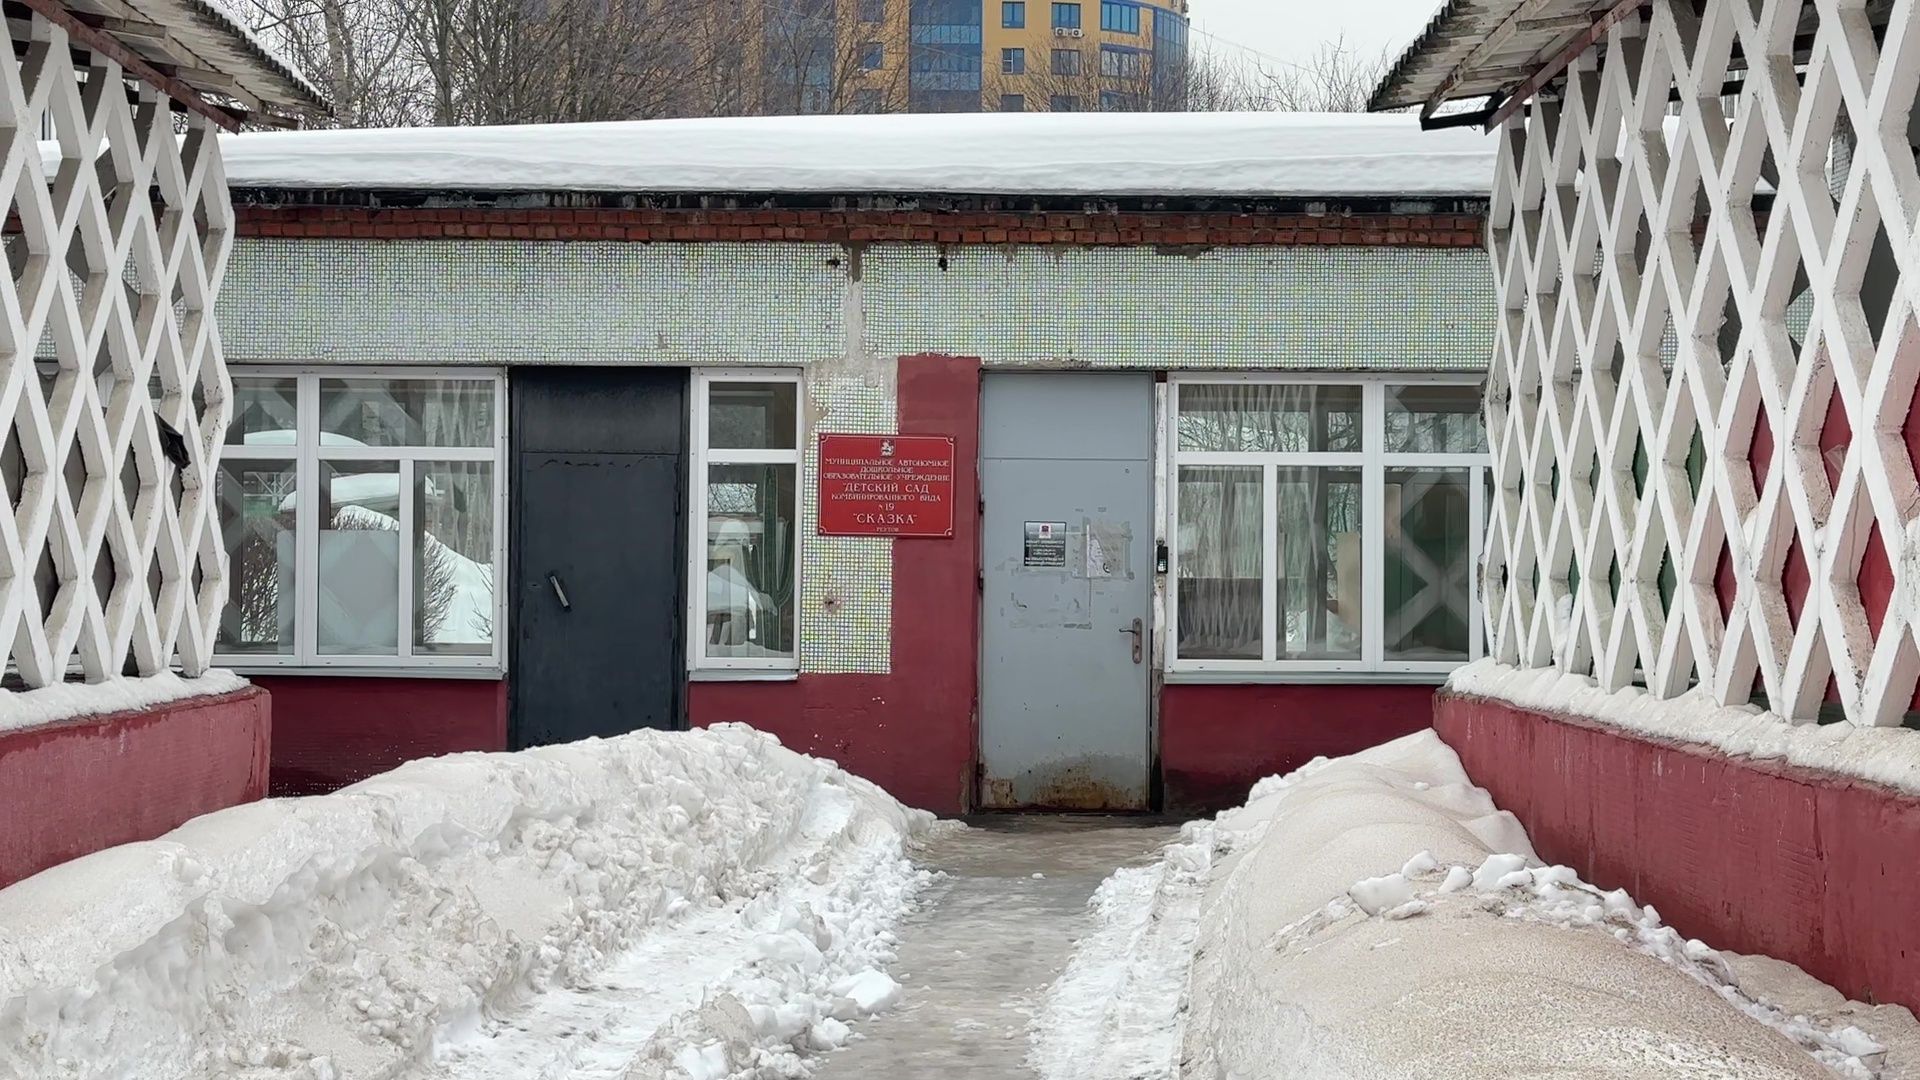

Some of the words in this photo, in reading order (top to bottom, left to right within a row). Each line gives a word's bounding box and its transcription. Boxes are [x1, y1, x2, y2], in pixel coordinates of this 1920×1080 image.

[898, 459, 949, 467] АВТОНОМНОЕ
[860, 466, 914, 474] ДОШКОЛЬНОЕ
[823, 472, 893, 480] ОБРАЗОВАТЕЛЬНОЕ
[905, 484, 930, 494] САД
[831, 493, 916, 501] КОМБИНИРОВАННОГО
[885, 502, 896, 511] 19
[853, 512, 918, 524] "СКАЗКА"
